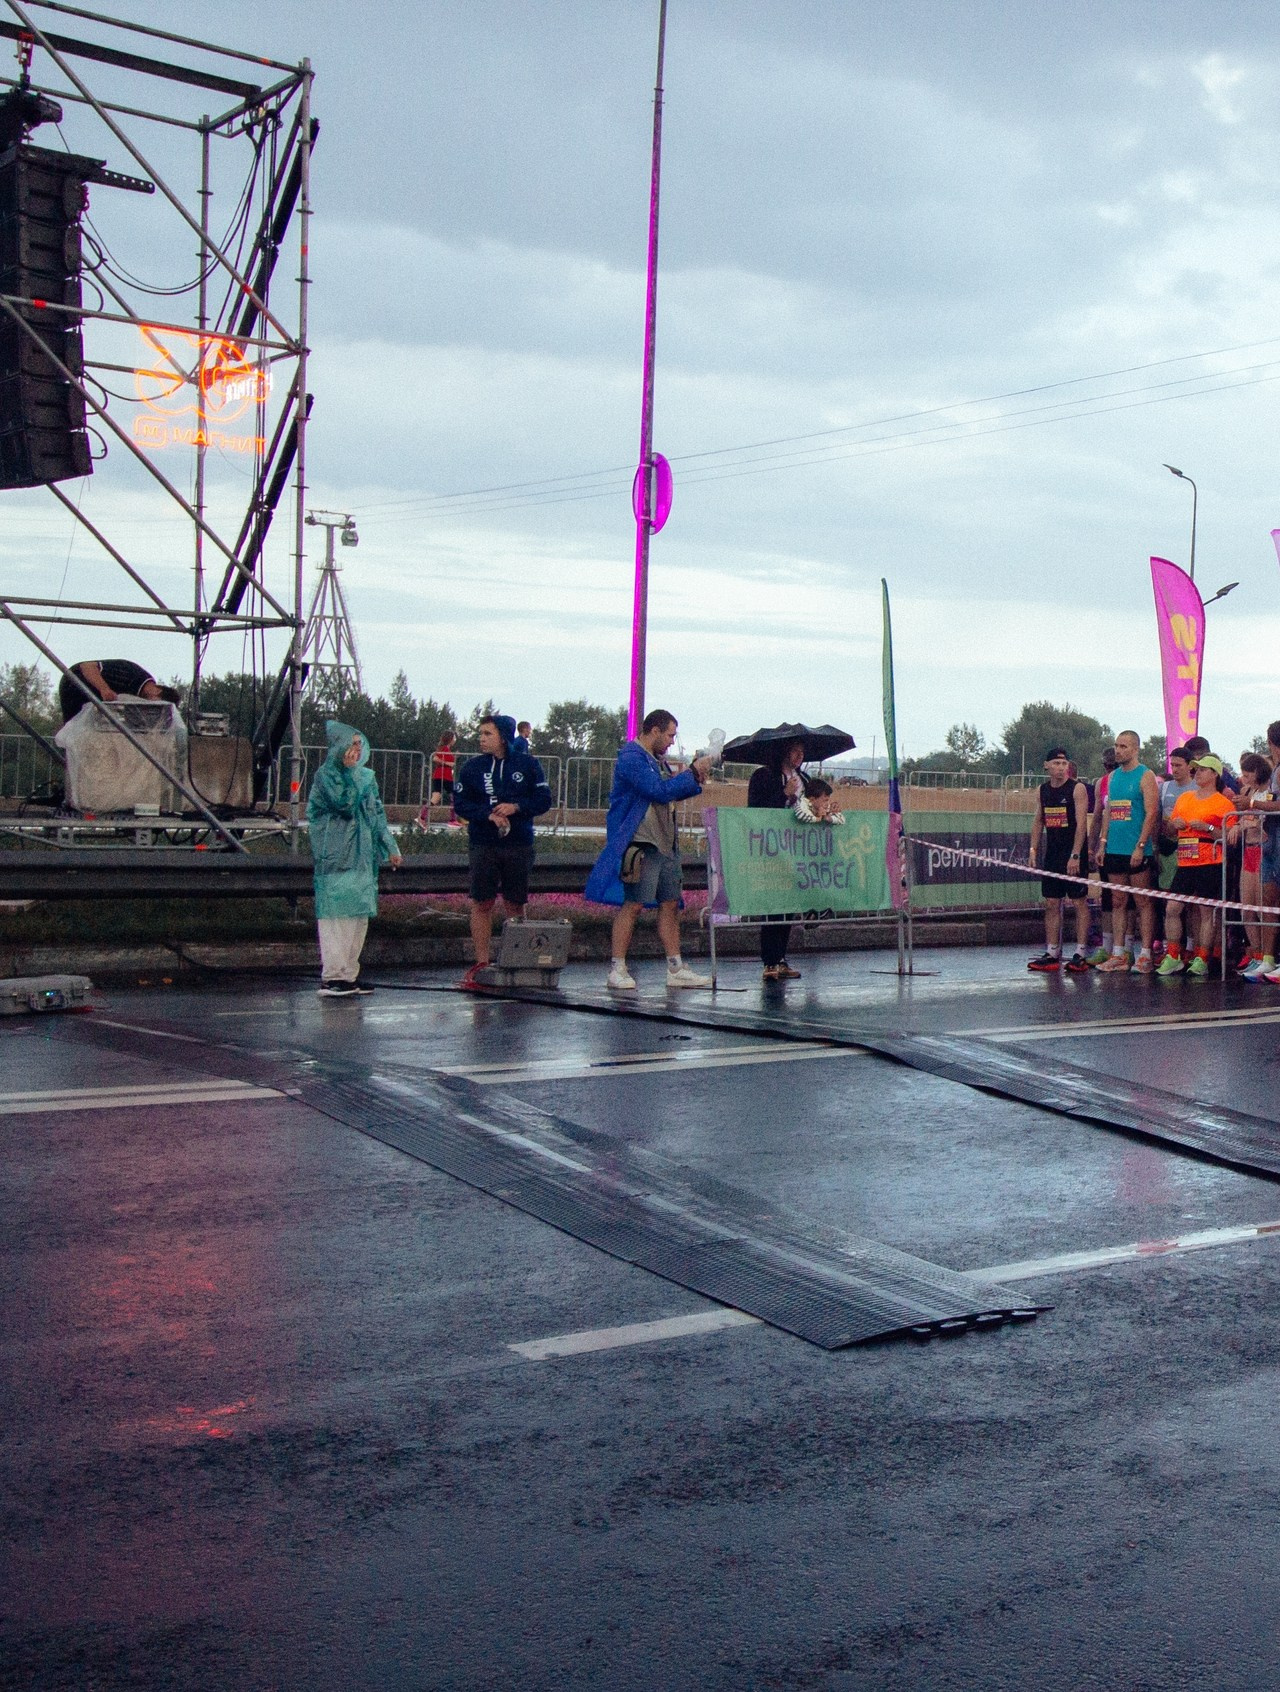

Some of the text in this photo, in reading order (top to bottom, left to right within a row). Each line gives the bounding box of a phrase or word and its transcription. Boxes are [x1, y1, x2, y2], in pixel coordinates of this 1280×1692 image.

[173, 428, 267, 455] МАГНИТ
[749, 825, 833, 857] НОЧНОЙ
[796, 861, 855, 891] ЗАБЕГ
